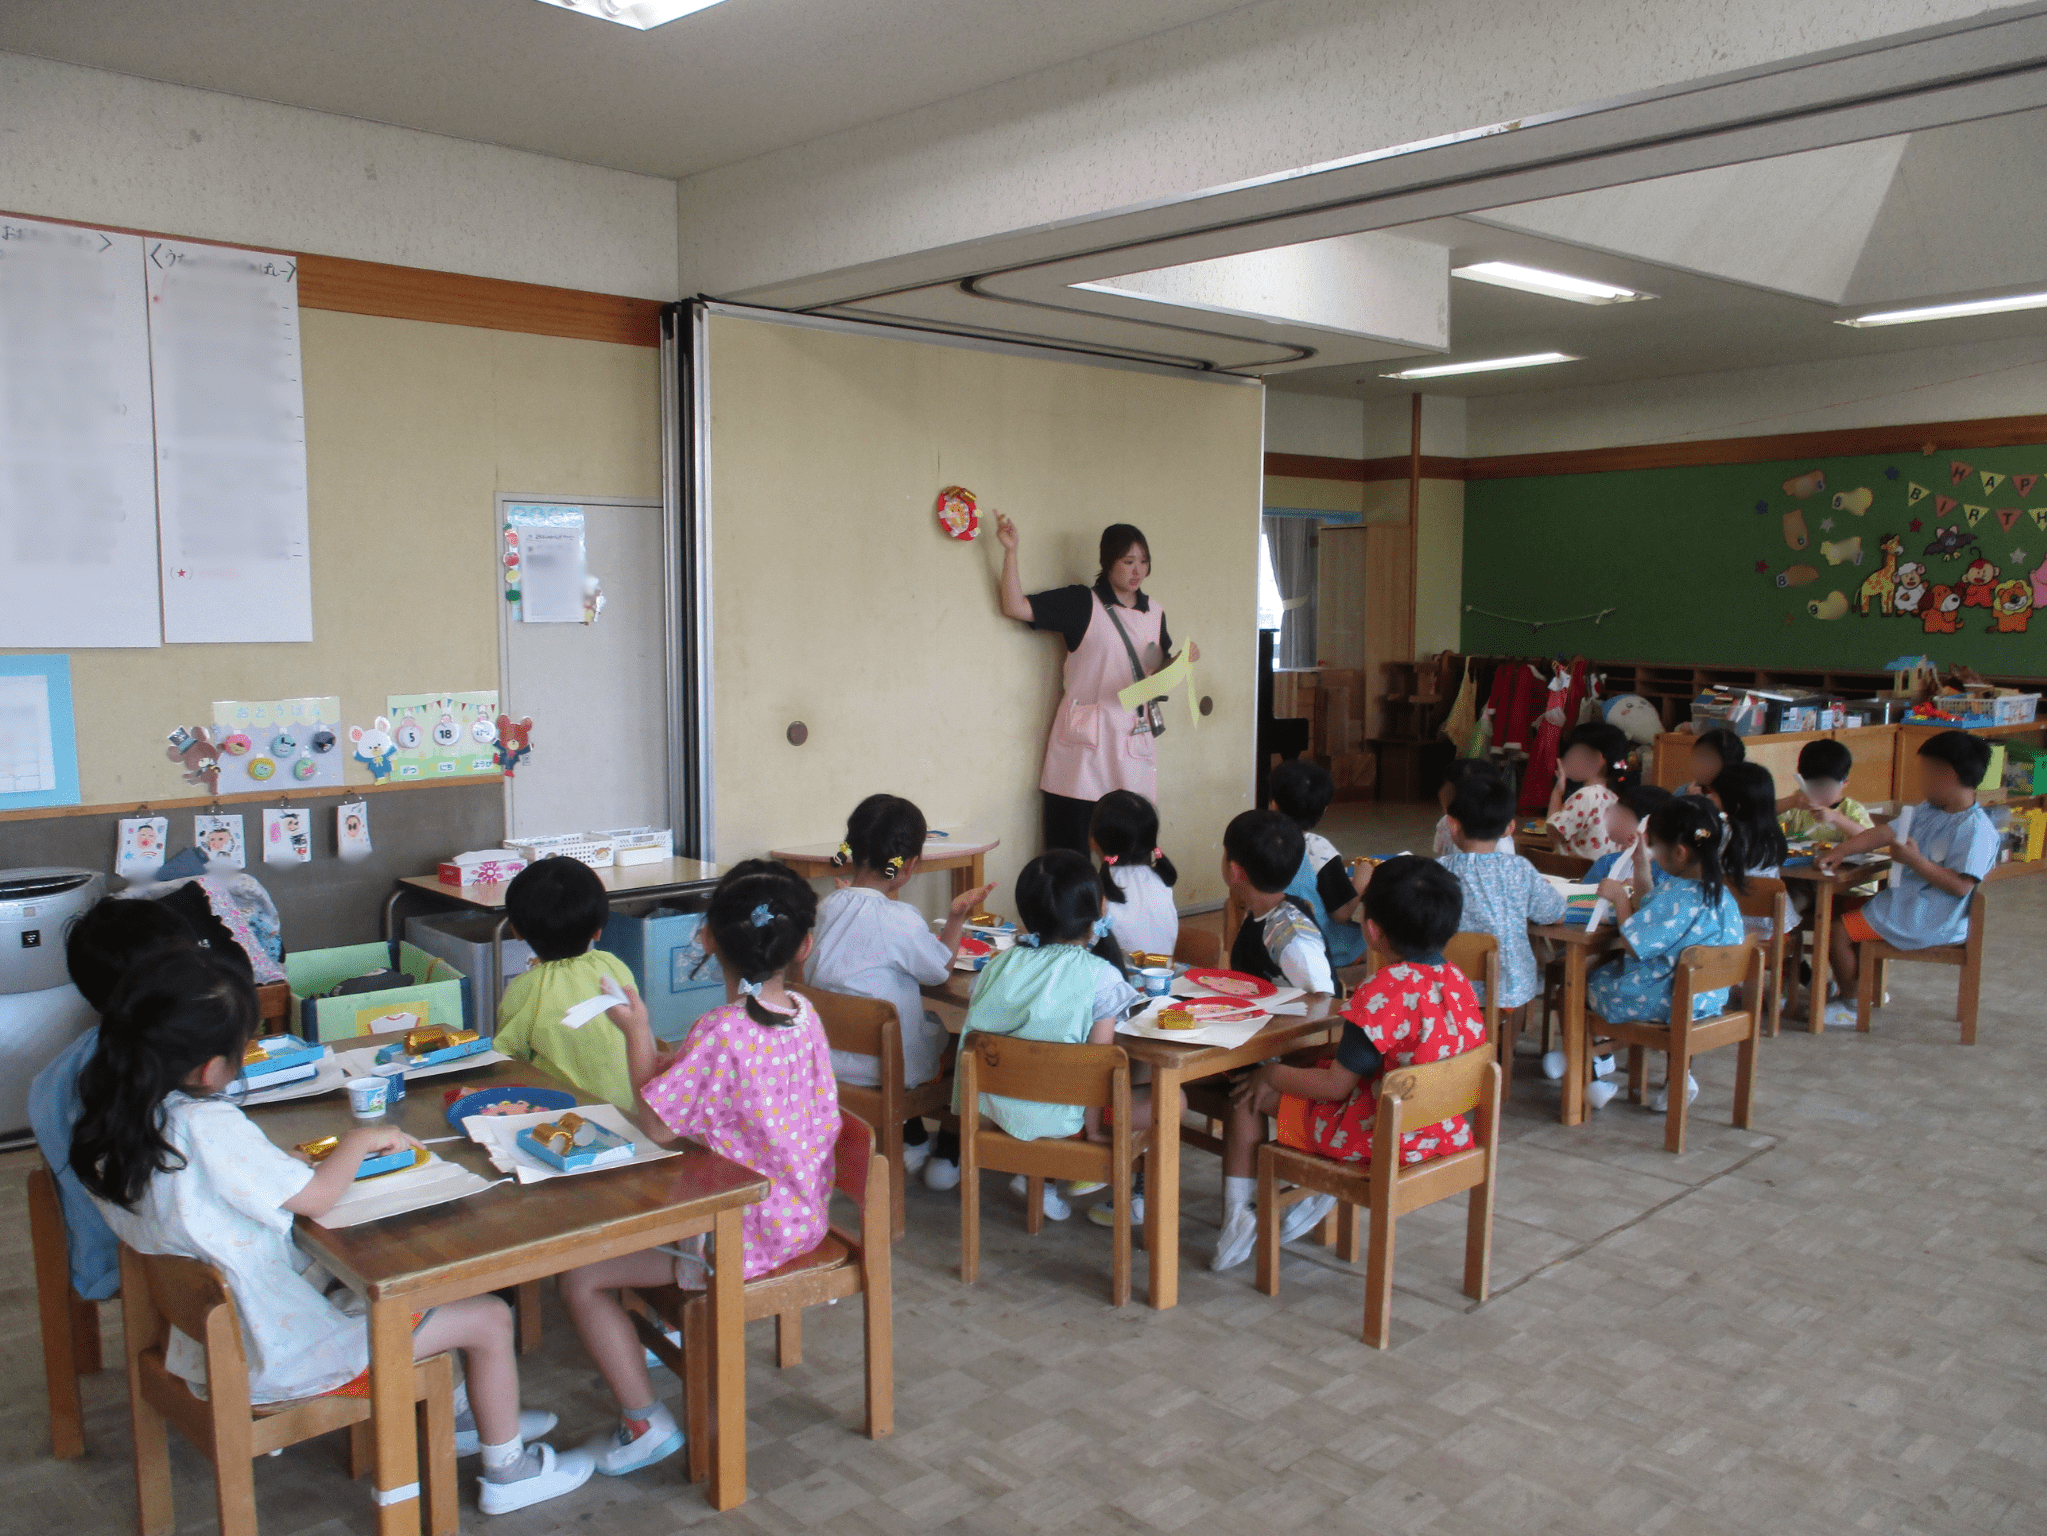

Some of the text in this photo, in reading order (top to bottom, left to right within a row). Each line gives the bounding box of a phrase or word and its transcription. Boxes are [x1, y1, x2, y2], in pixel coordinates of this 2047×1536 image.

[1777, 575, 1787, 587] 8
[409, 732, 415, 742] 5
[439, 729, 452, 739] 18
